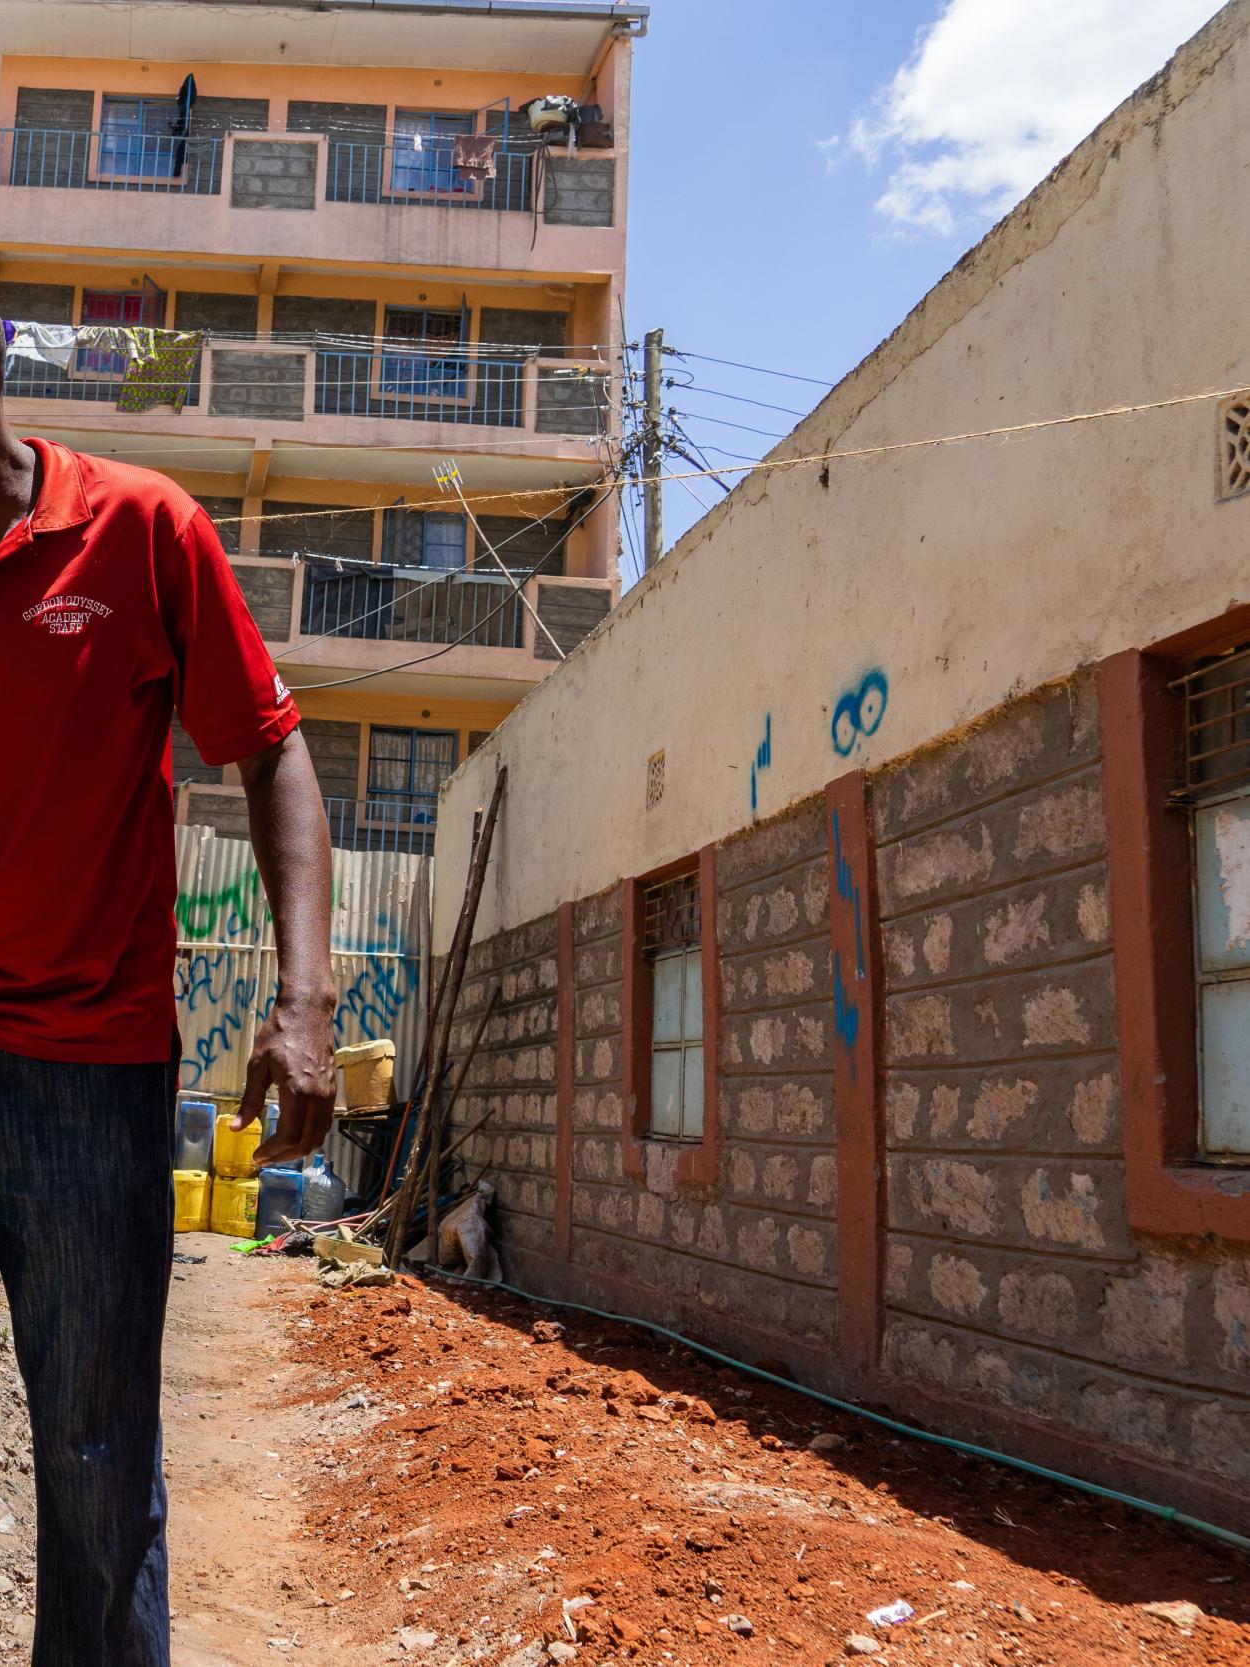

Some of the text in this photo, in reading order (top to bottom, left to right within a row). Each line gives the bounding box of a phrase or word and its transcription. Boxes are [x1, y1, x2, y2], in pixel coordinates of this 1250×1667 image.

[22, 595, 113, 621] GORDON ODYSSEY
[41, 612, 92, 624] ACADEMY
[49, 623, 83, 634] STAFF
